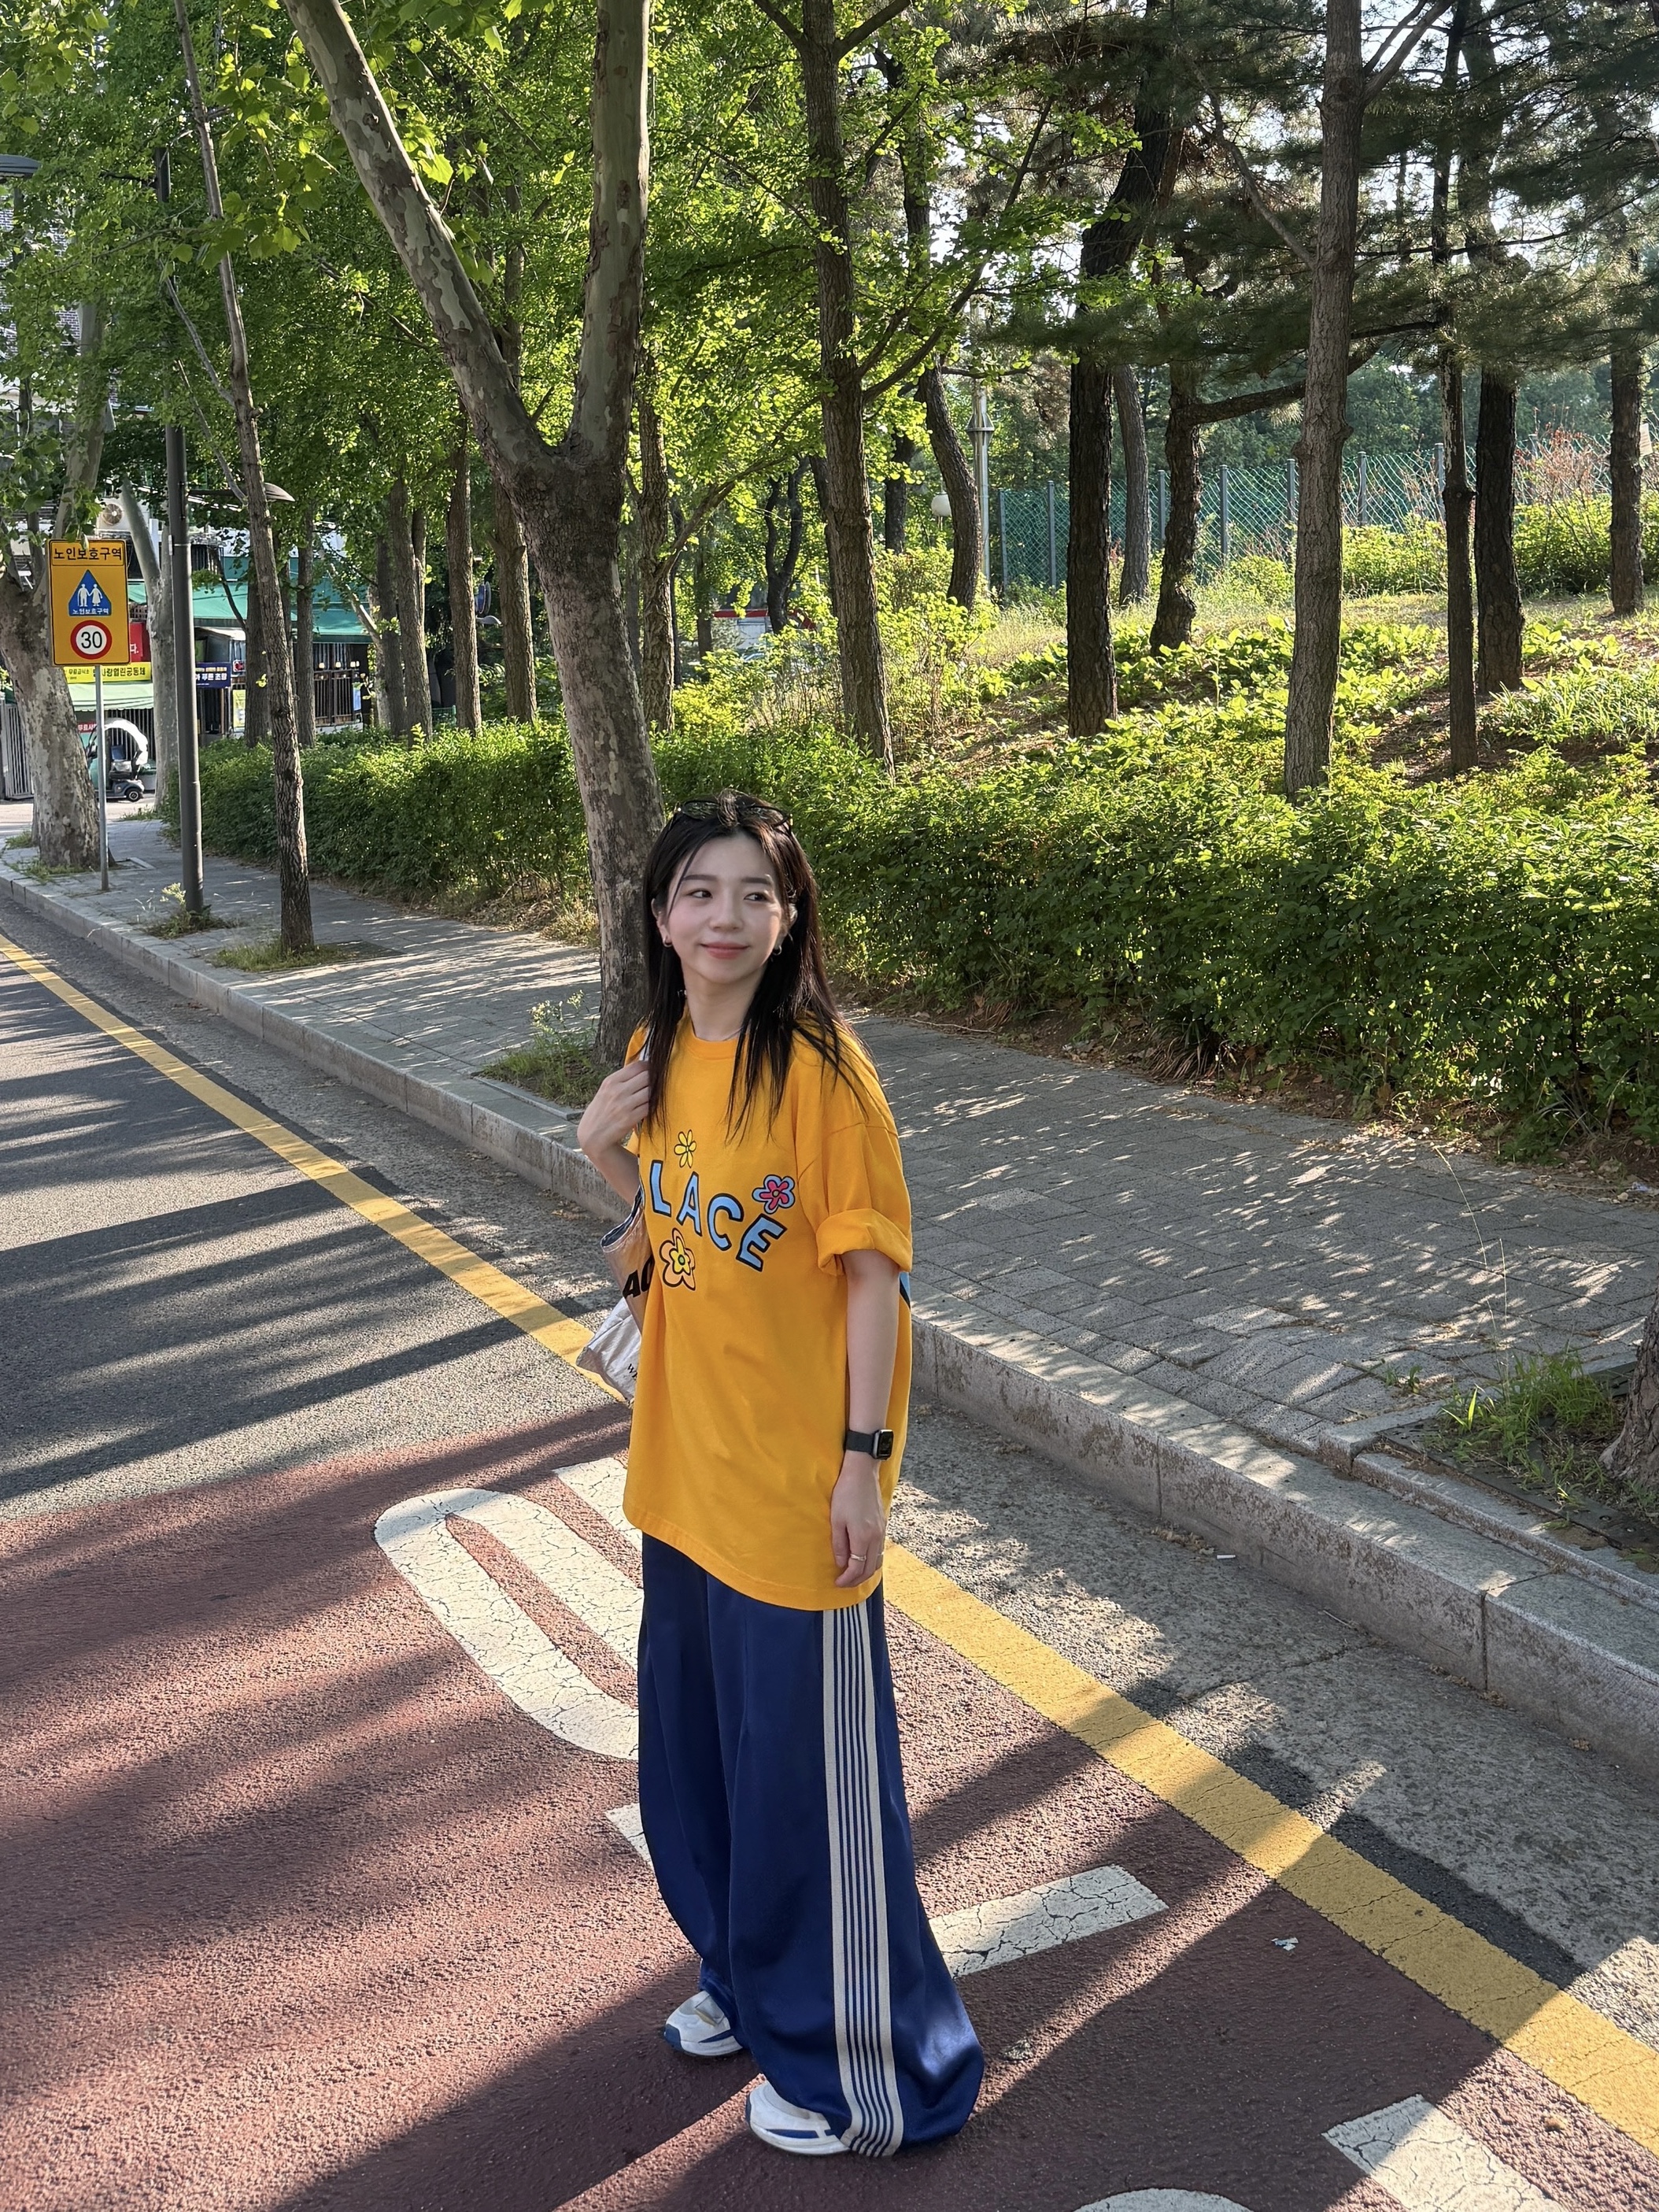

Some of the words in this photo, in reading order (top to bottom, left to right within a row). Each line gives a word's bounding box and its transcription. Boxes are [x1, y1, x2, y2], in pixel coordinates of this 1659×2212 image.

[54, 547, 122, 560] 노인보호구역
[81, 631, 102, 649] 30
[649, 1160, 788, 1272] LACE
